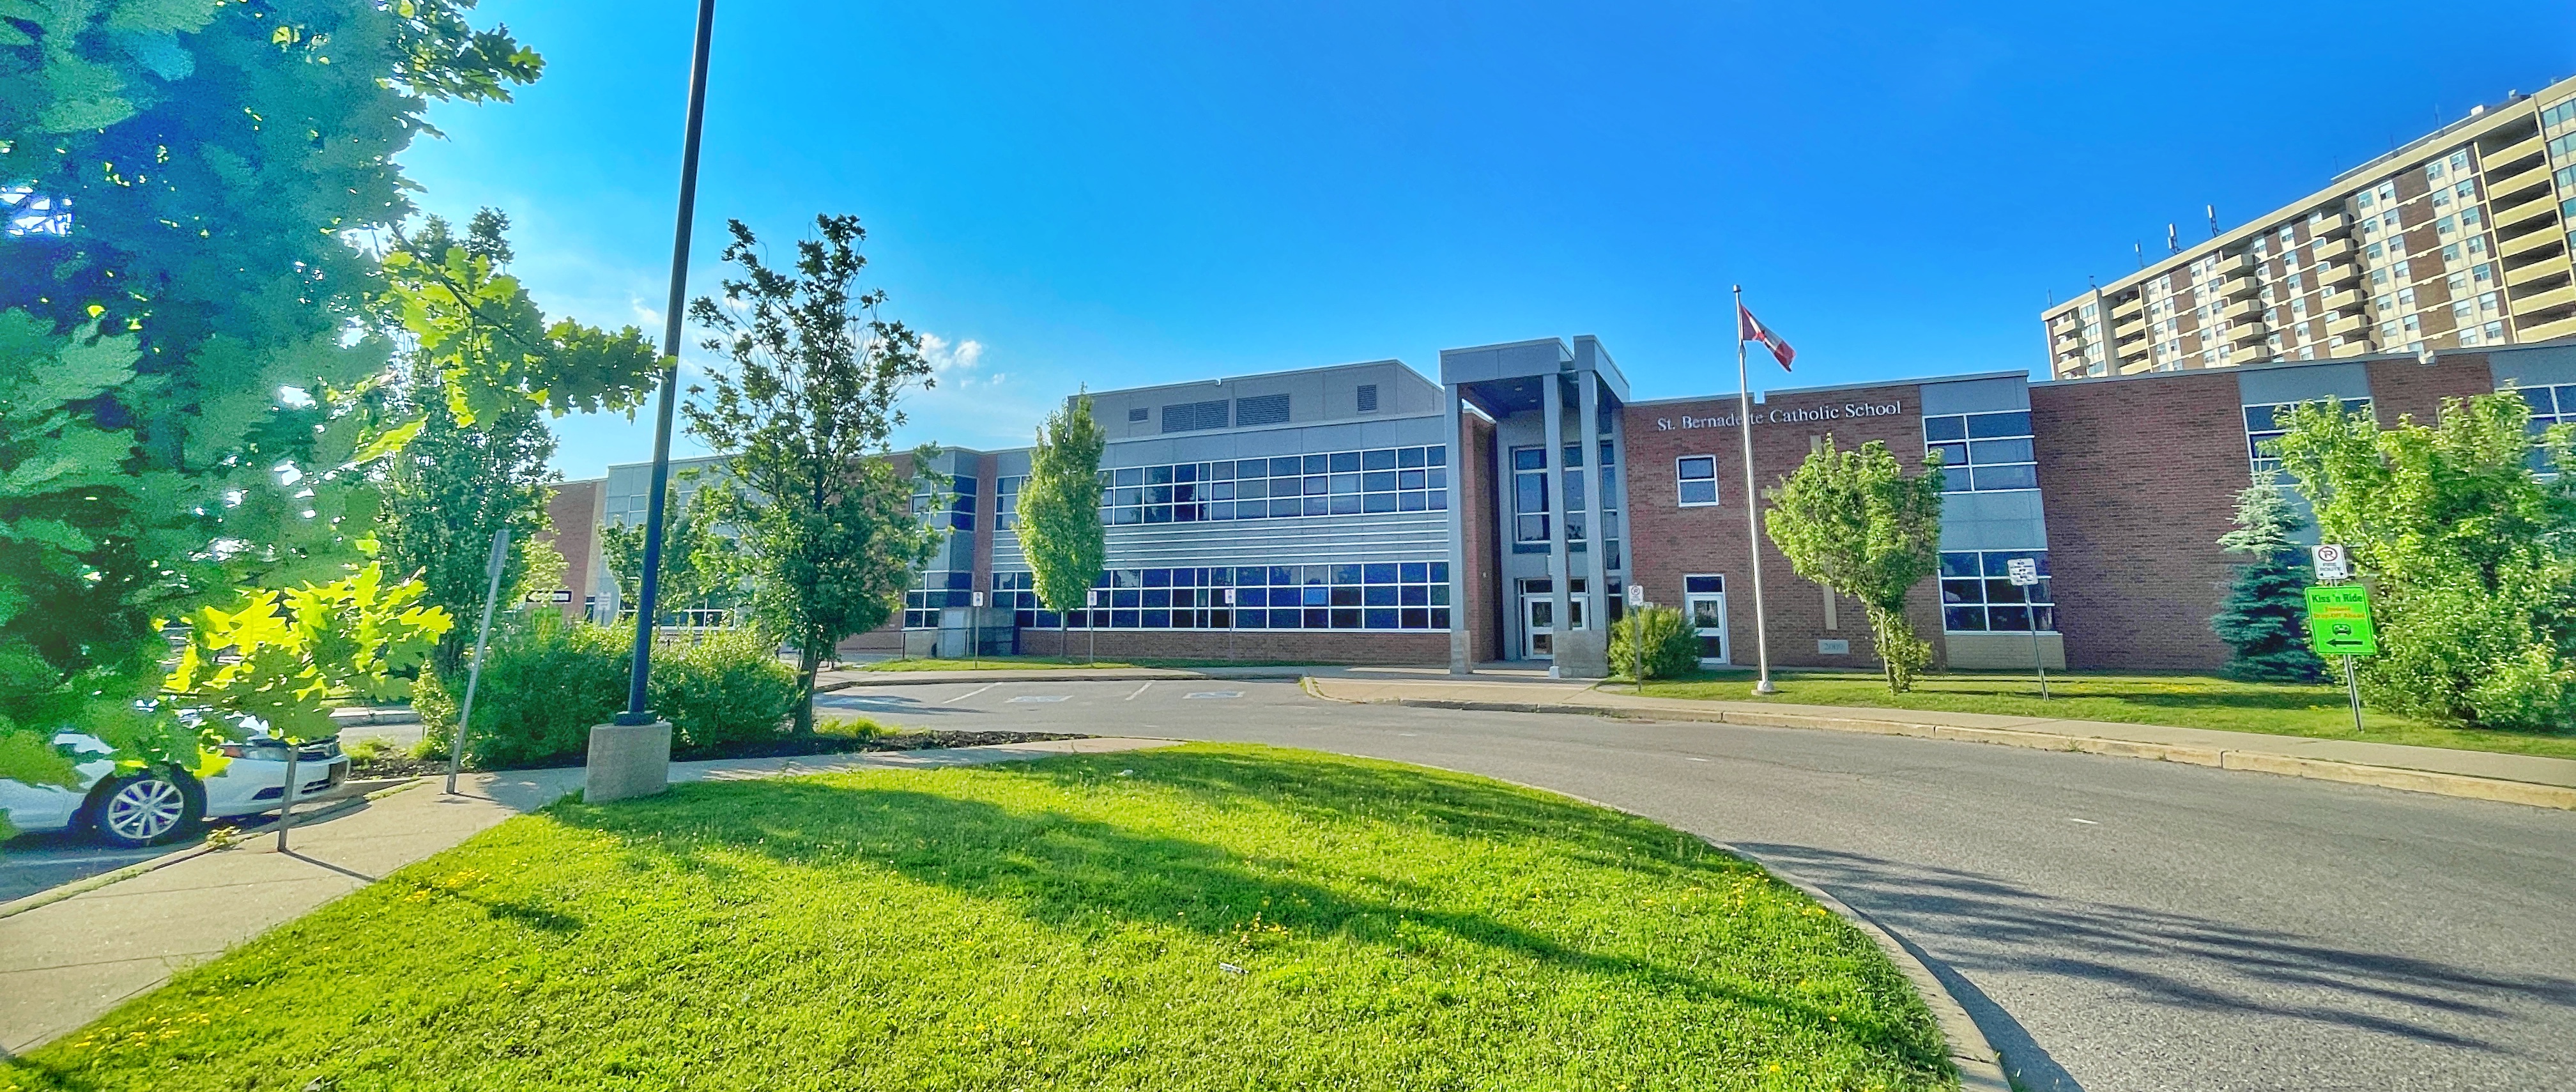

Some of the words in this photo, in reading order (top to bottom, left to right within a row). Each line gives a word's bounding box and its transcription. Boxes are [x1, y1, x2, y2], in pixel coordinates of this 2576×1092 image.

[1657, 417, 1676, 431] St.
[1682, 413, 1764, 429] Bernadete
[1769, 405, 1839, 423] Catholic
[1844, 401, 1902, 418] School
[2312, 594, 2331, 603] Kiss
[2343, 593, 2363, 602] Ride
